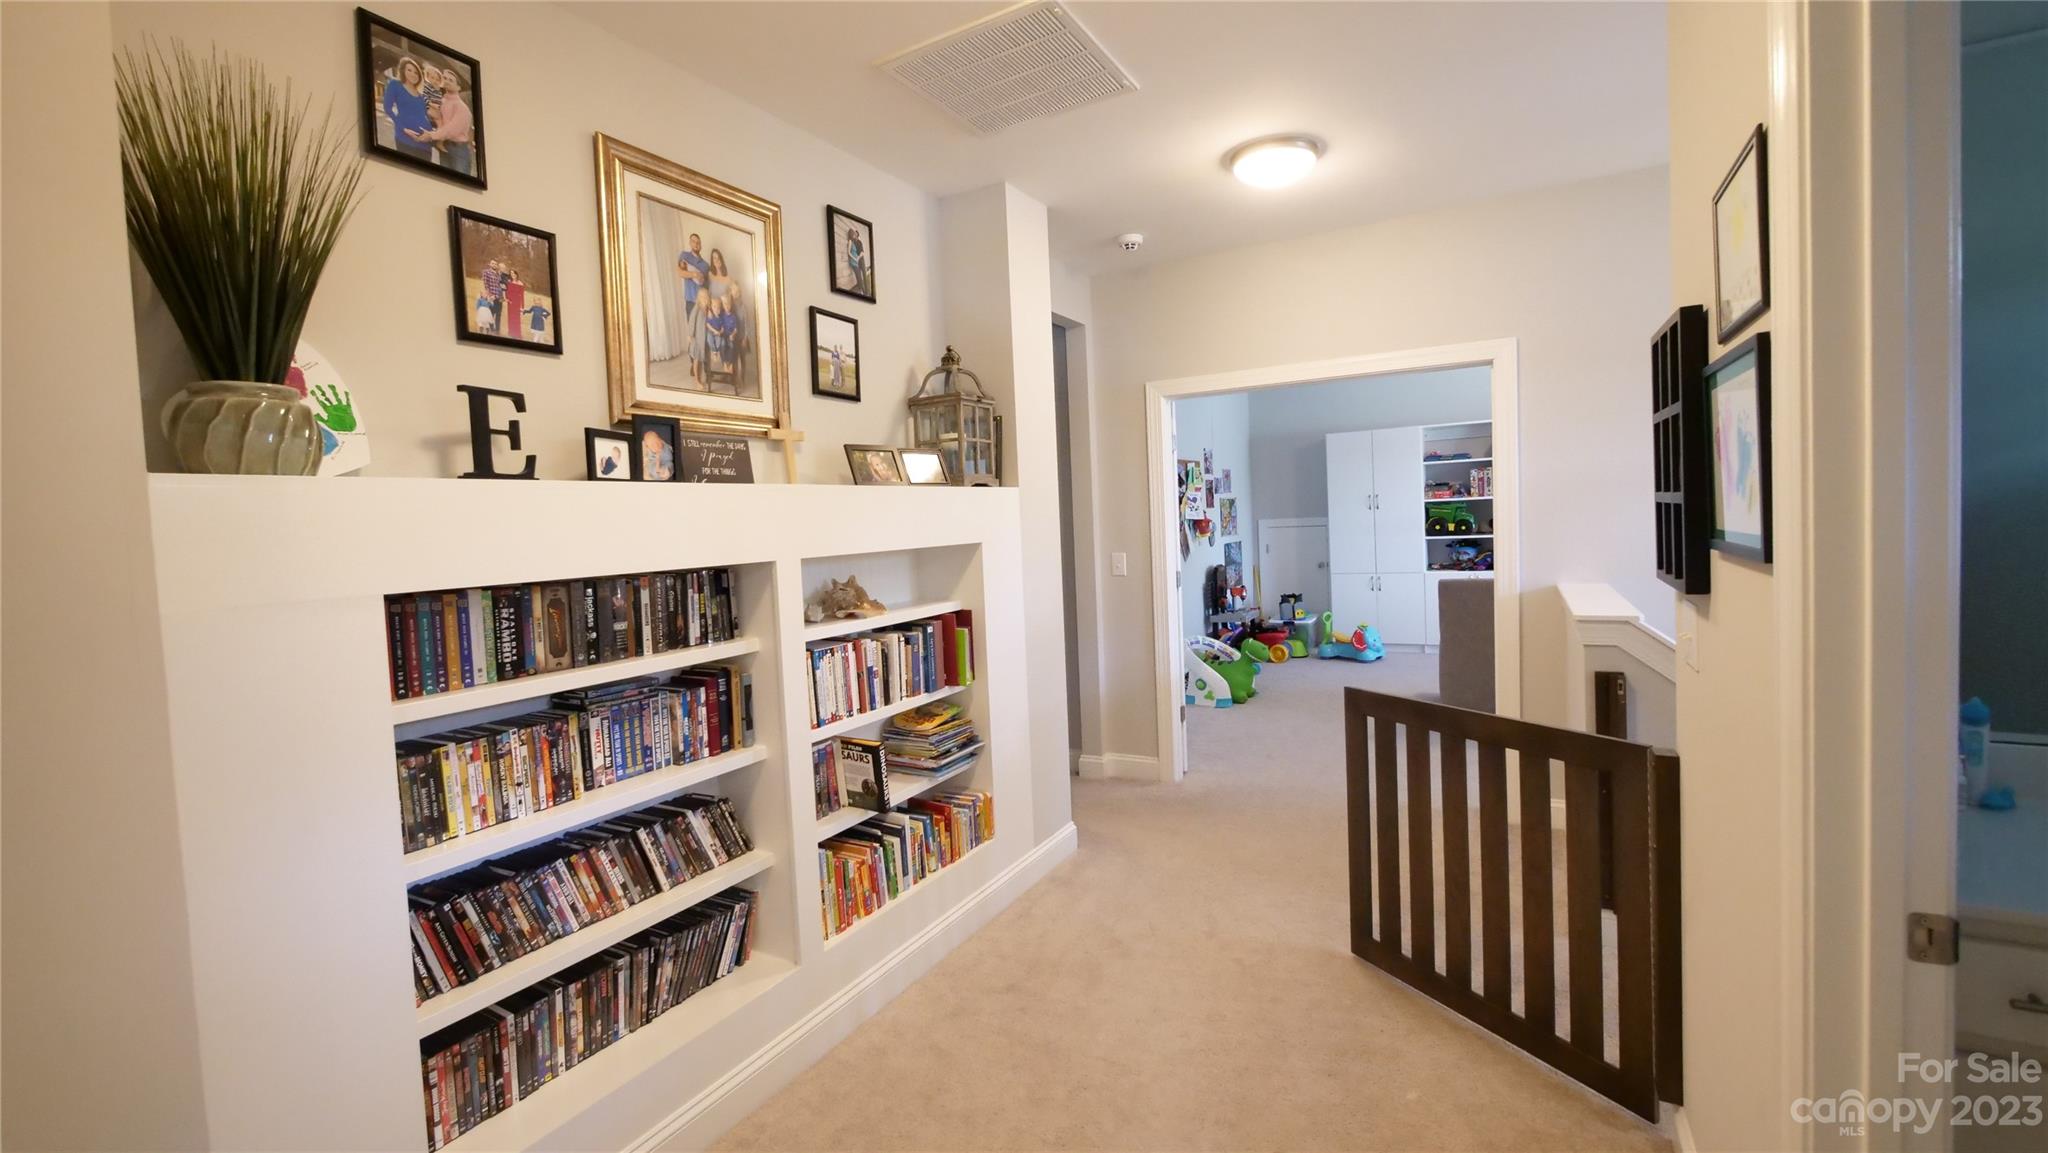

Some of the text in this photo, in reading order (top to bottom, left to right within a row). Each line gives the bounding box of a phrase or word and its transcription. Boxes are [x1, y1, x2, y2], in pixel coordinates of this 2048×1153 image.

[457, 384, 540, 480] E
[687, 439, 700, 448] STILL
[500, 608, 512, 663] RAMBO
[509, 607, 518, 661] STALLONE
[585, 597, 594, 628] jackass
[602, 720, 613, 768] MUHAMMAD ALI
[841, 750, 870, 764] SAURS
[879, 749, 890, 801] DINOSAURS
